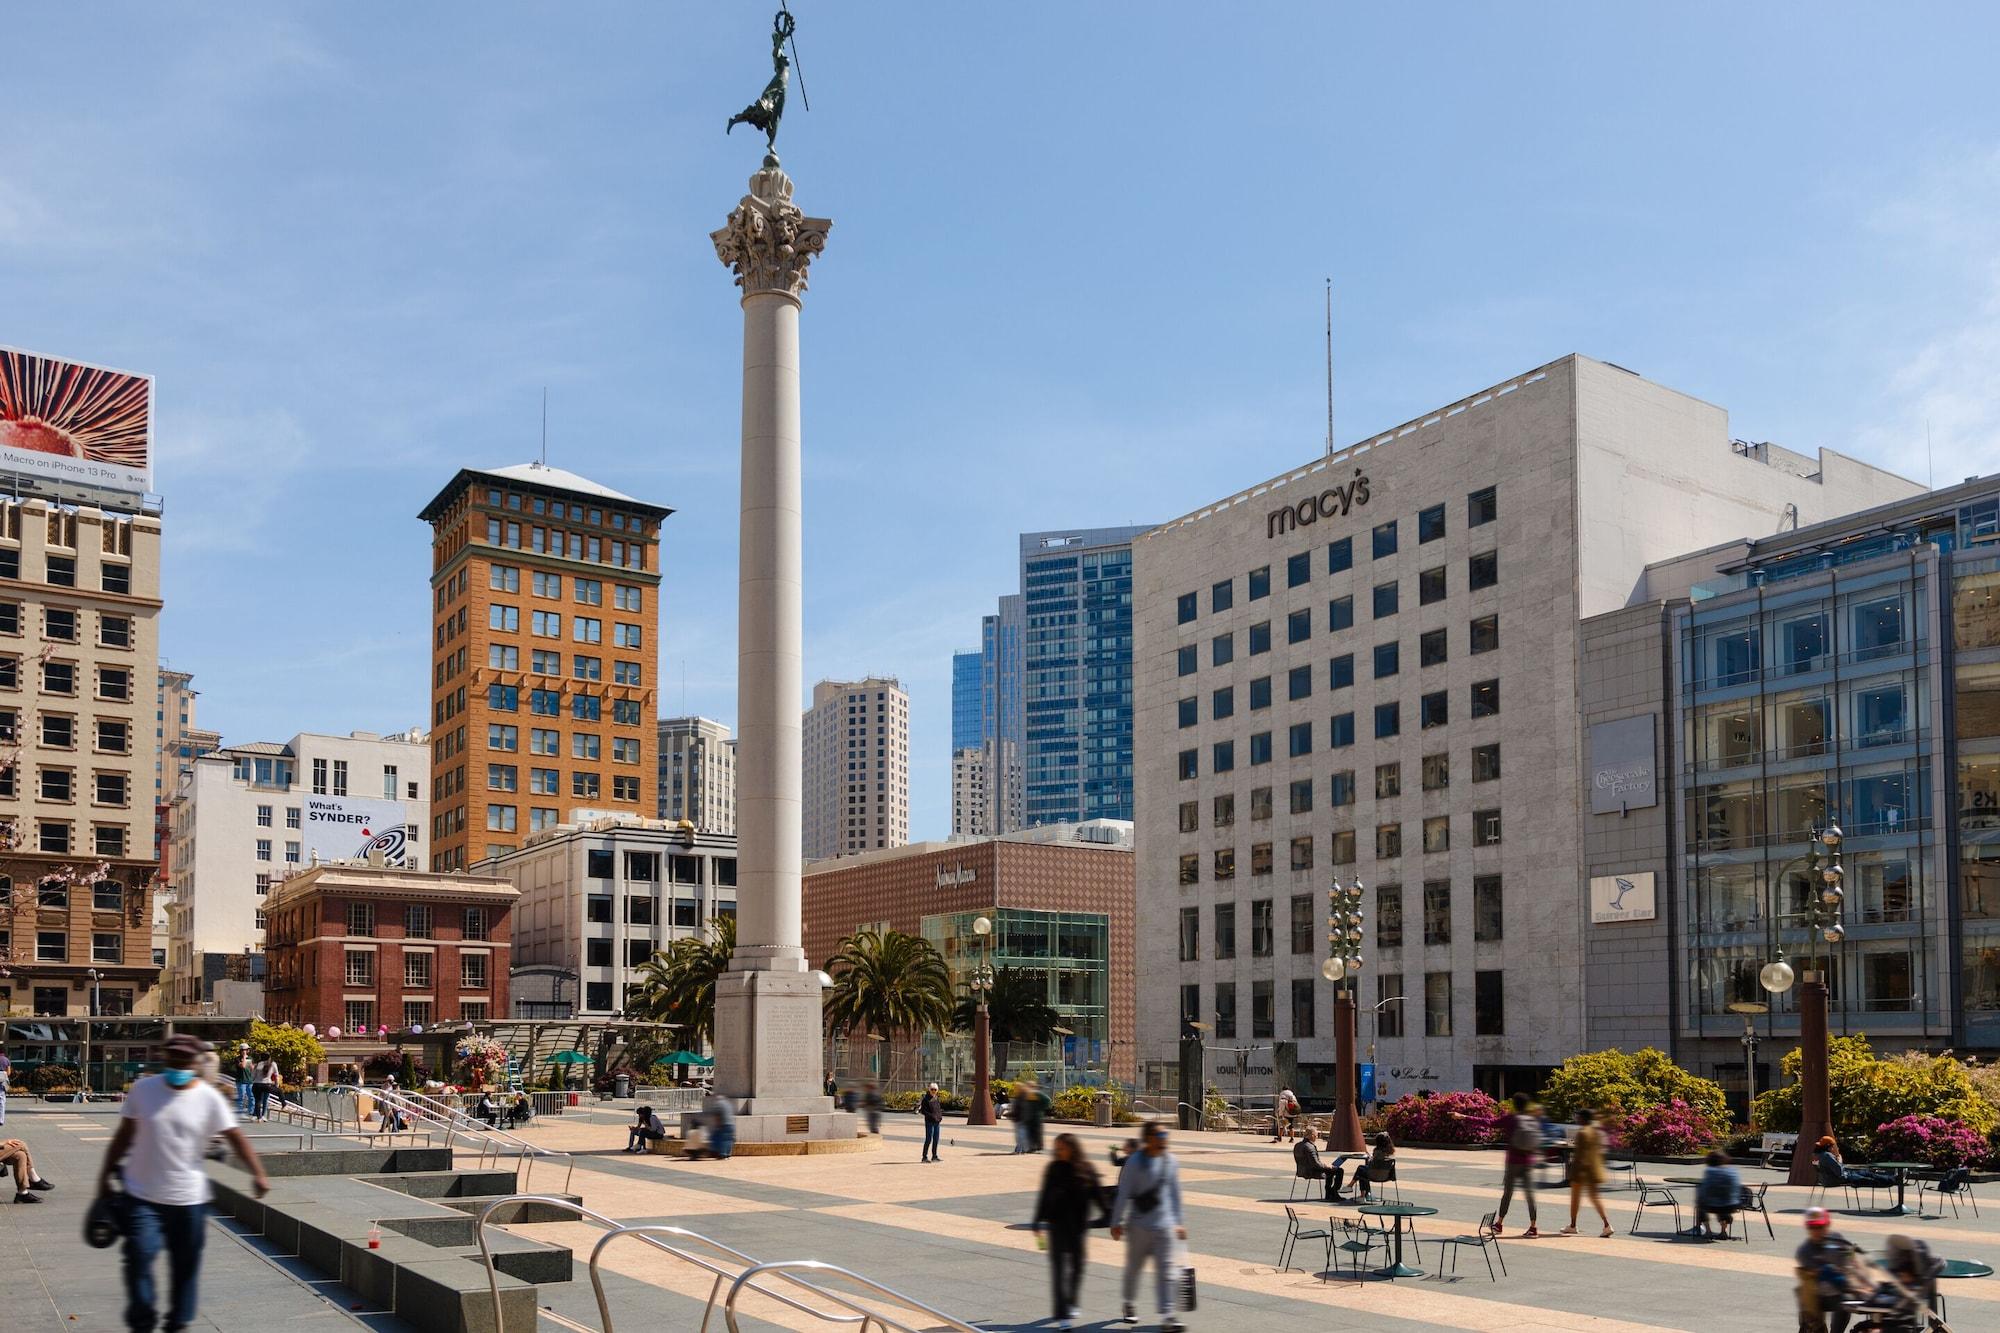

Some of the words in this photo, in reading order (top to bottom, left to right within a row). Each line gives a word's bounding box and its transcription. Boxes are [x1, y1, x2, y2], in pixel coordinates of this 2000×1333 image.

[4, 452, 35, 466] Macro
[37, 460, 50, 469] on
[51, 461, 86, 474] iPhone
[87, 467, 98, 476] 13
[100, 469, 117, 480] Pro
[1606, 779, 1650, 797] Factory
[309, 801, 343, 811] What's
[309, 811, 370, 824] SYNDER?
